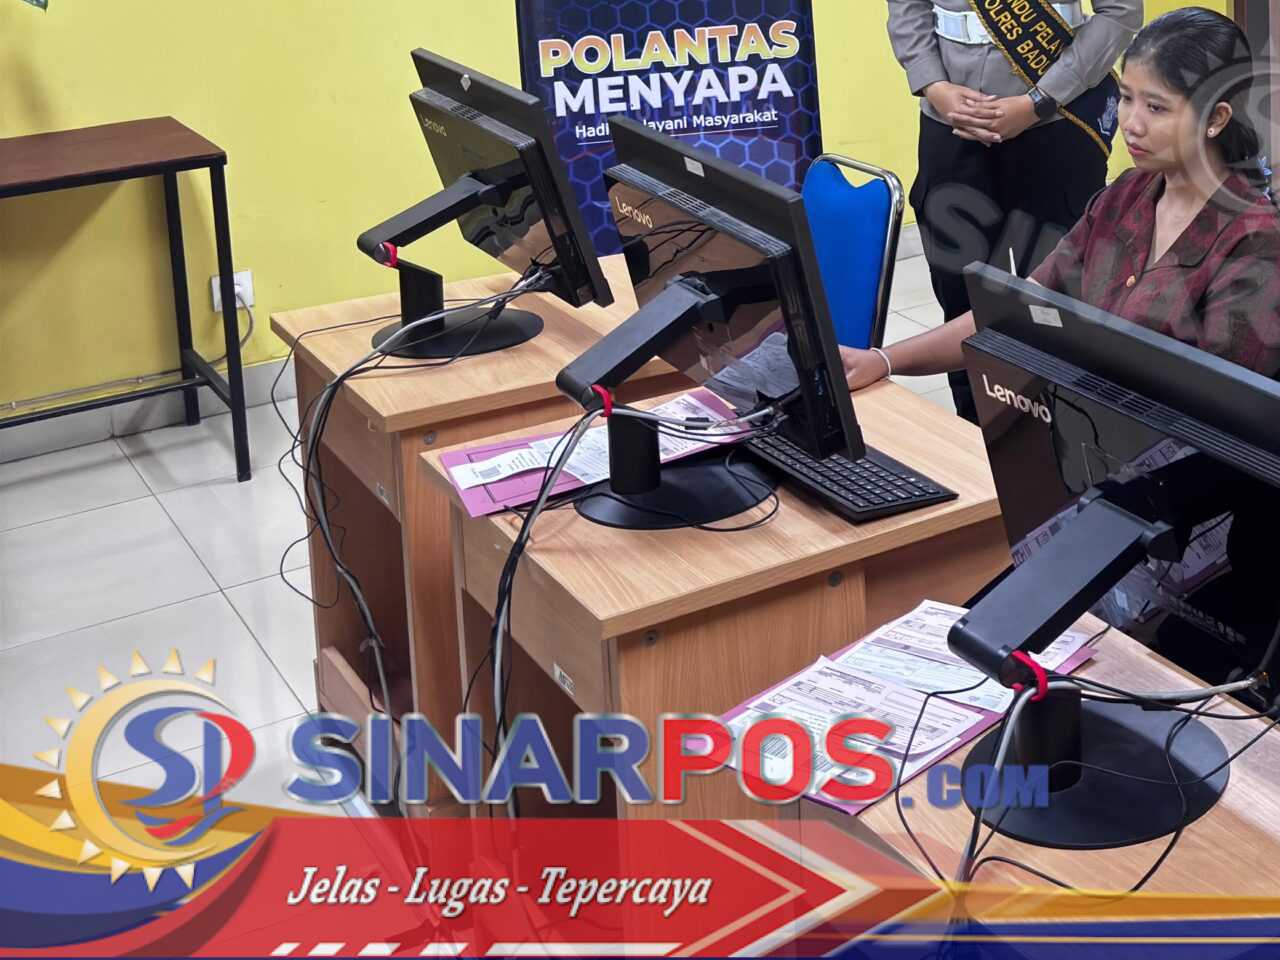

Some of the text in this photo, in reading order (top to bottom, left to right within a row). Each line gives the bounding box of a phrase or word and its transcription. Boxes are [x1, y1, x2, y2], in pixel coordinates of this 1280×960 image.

[538, 20, 800, 78] POLANTAS
[553, 63, 795, 117] MENYAPA
[419, 113, 448, 137] Lenovo
[692, 108, 779, 128] Masyarakat
[614, 194, 654, 229] Lenovo
[982, 374, 1053, 424] Lenovo
